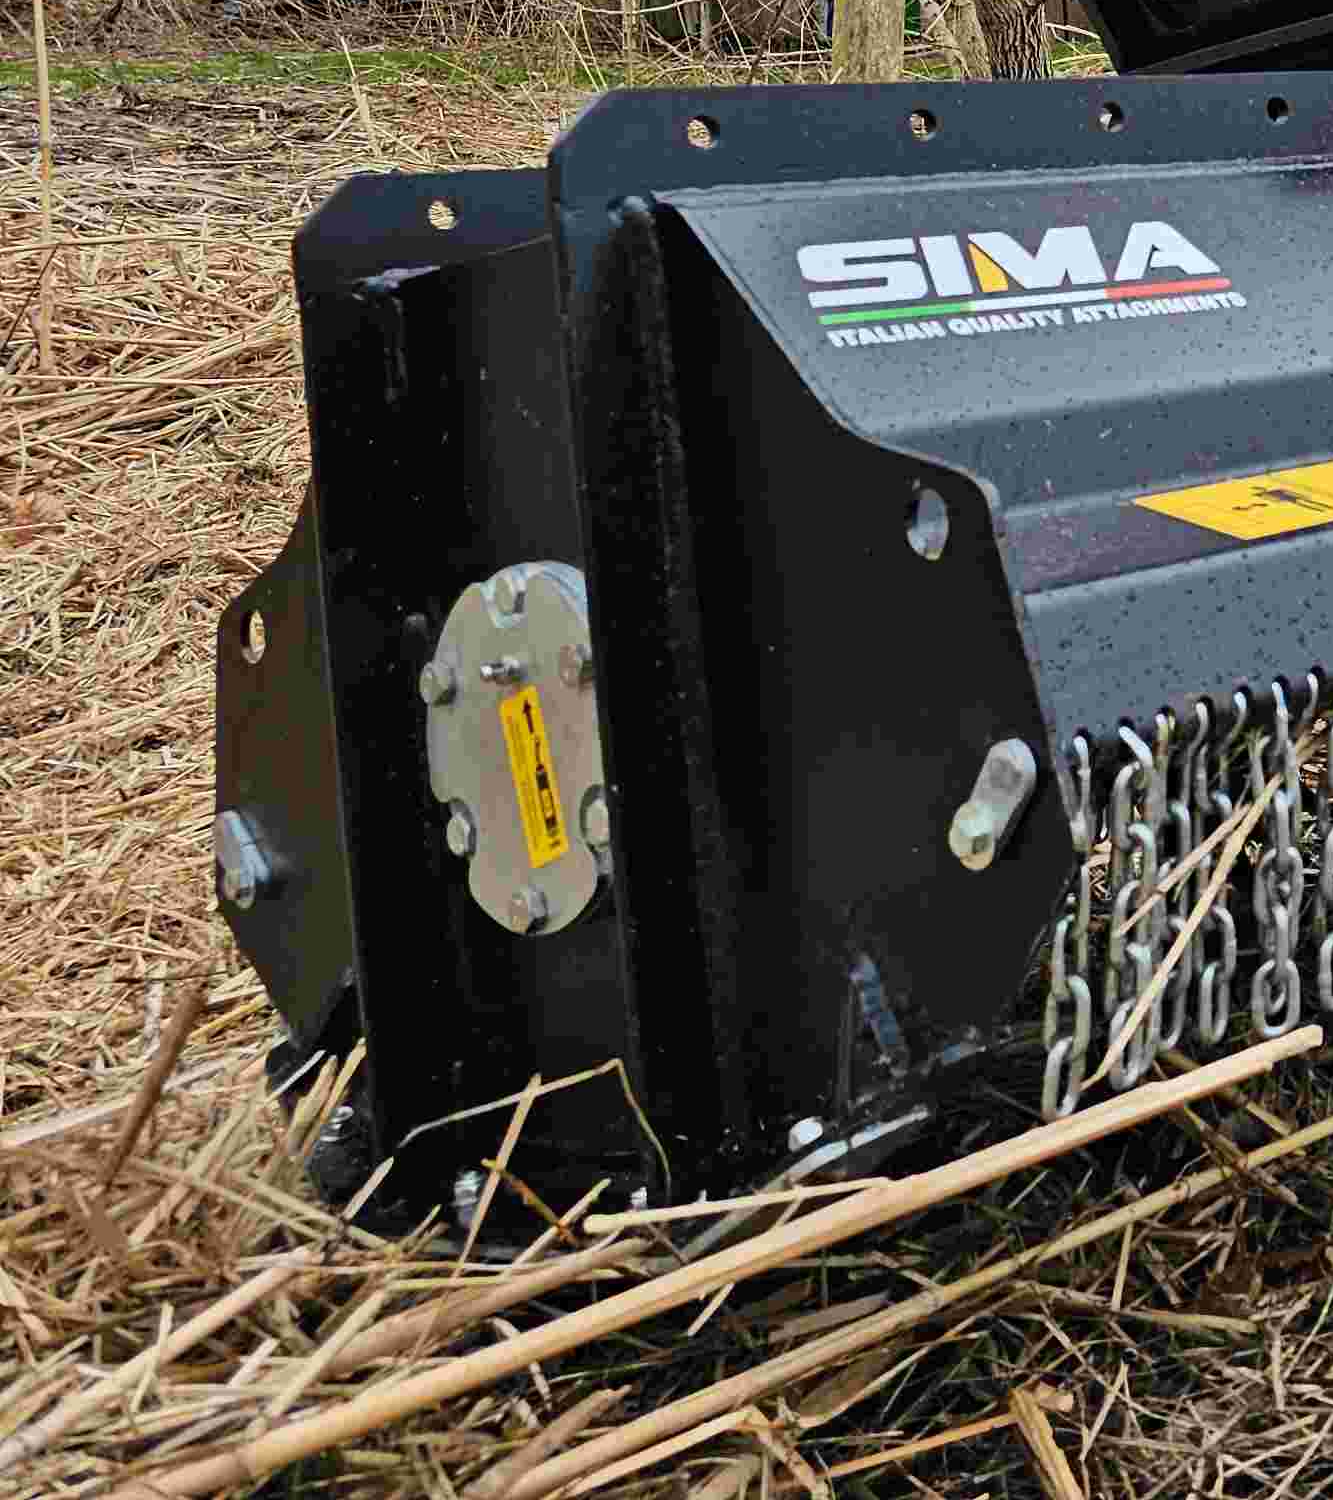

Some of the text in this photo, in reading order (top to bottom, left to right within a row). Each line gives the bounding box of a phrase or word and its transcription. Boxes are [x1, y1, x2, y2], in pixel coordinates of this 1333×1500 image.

[796, 220, 1222, 308] SIMA
[827, 291, 1248, 348] ITALIAN QUALITY ATTACHMENTS
